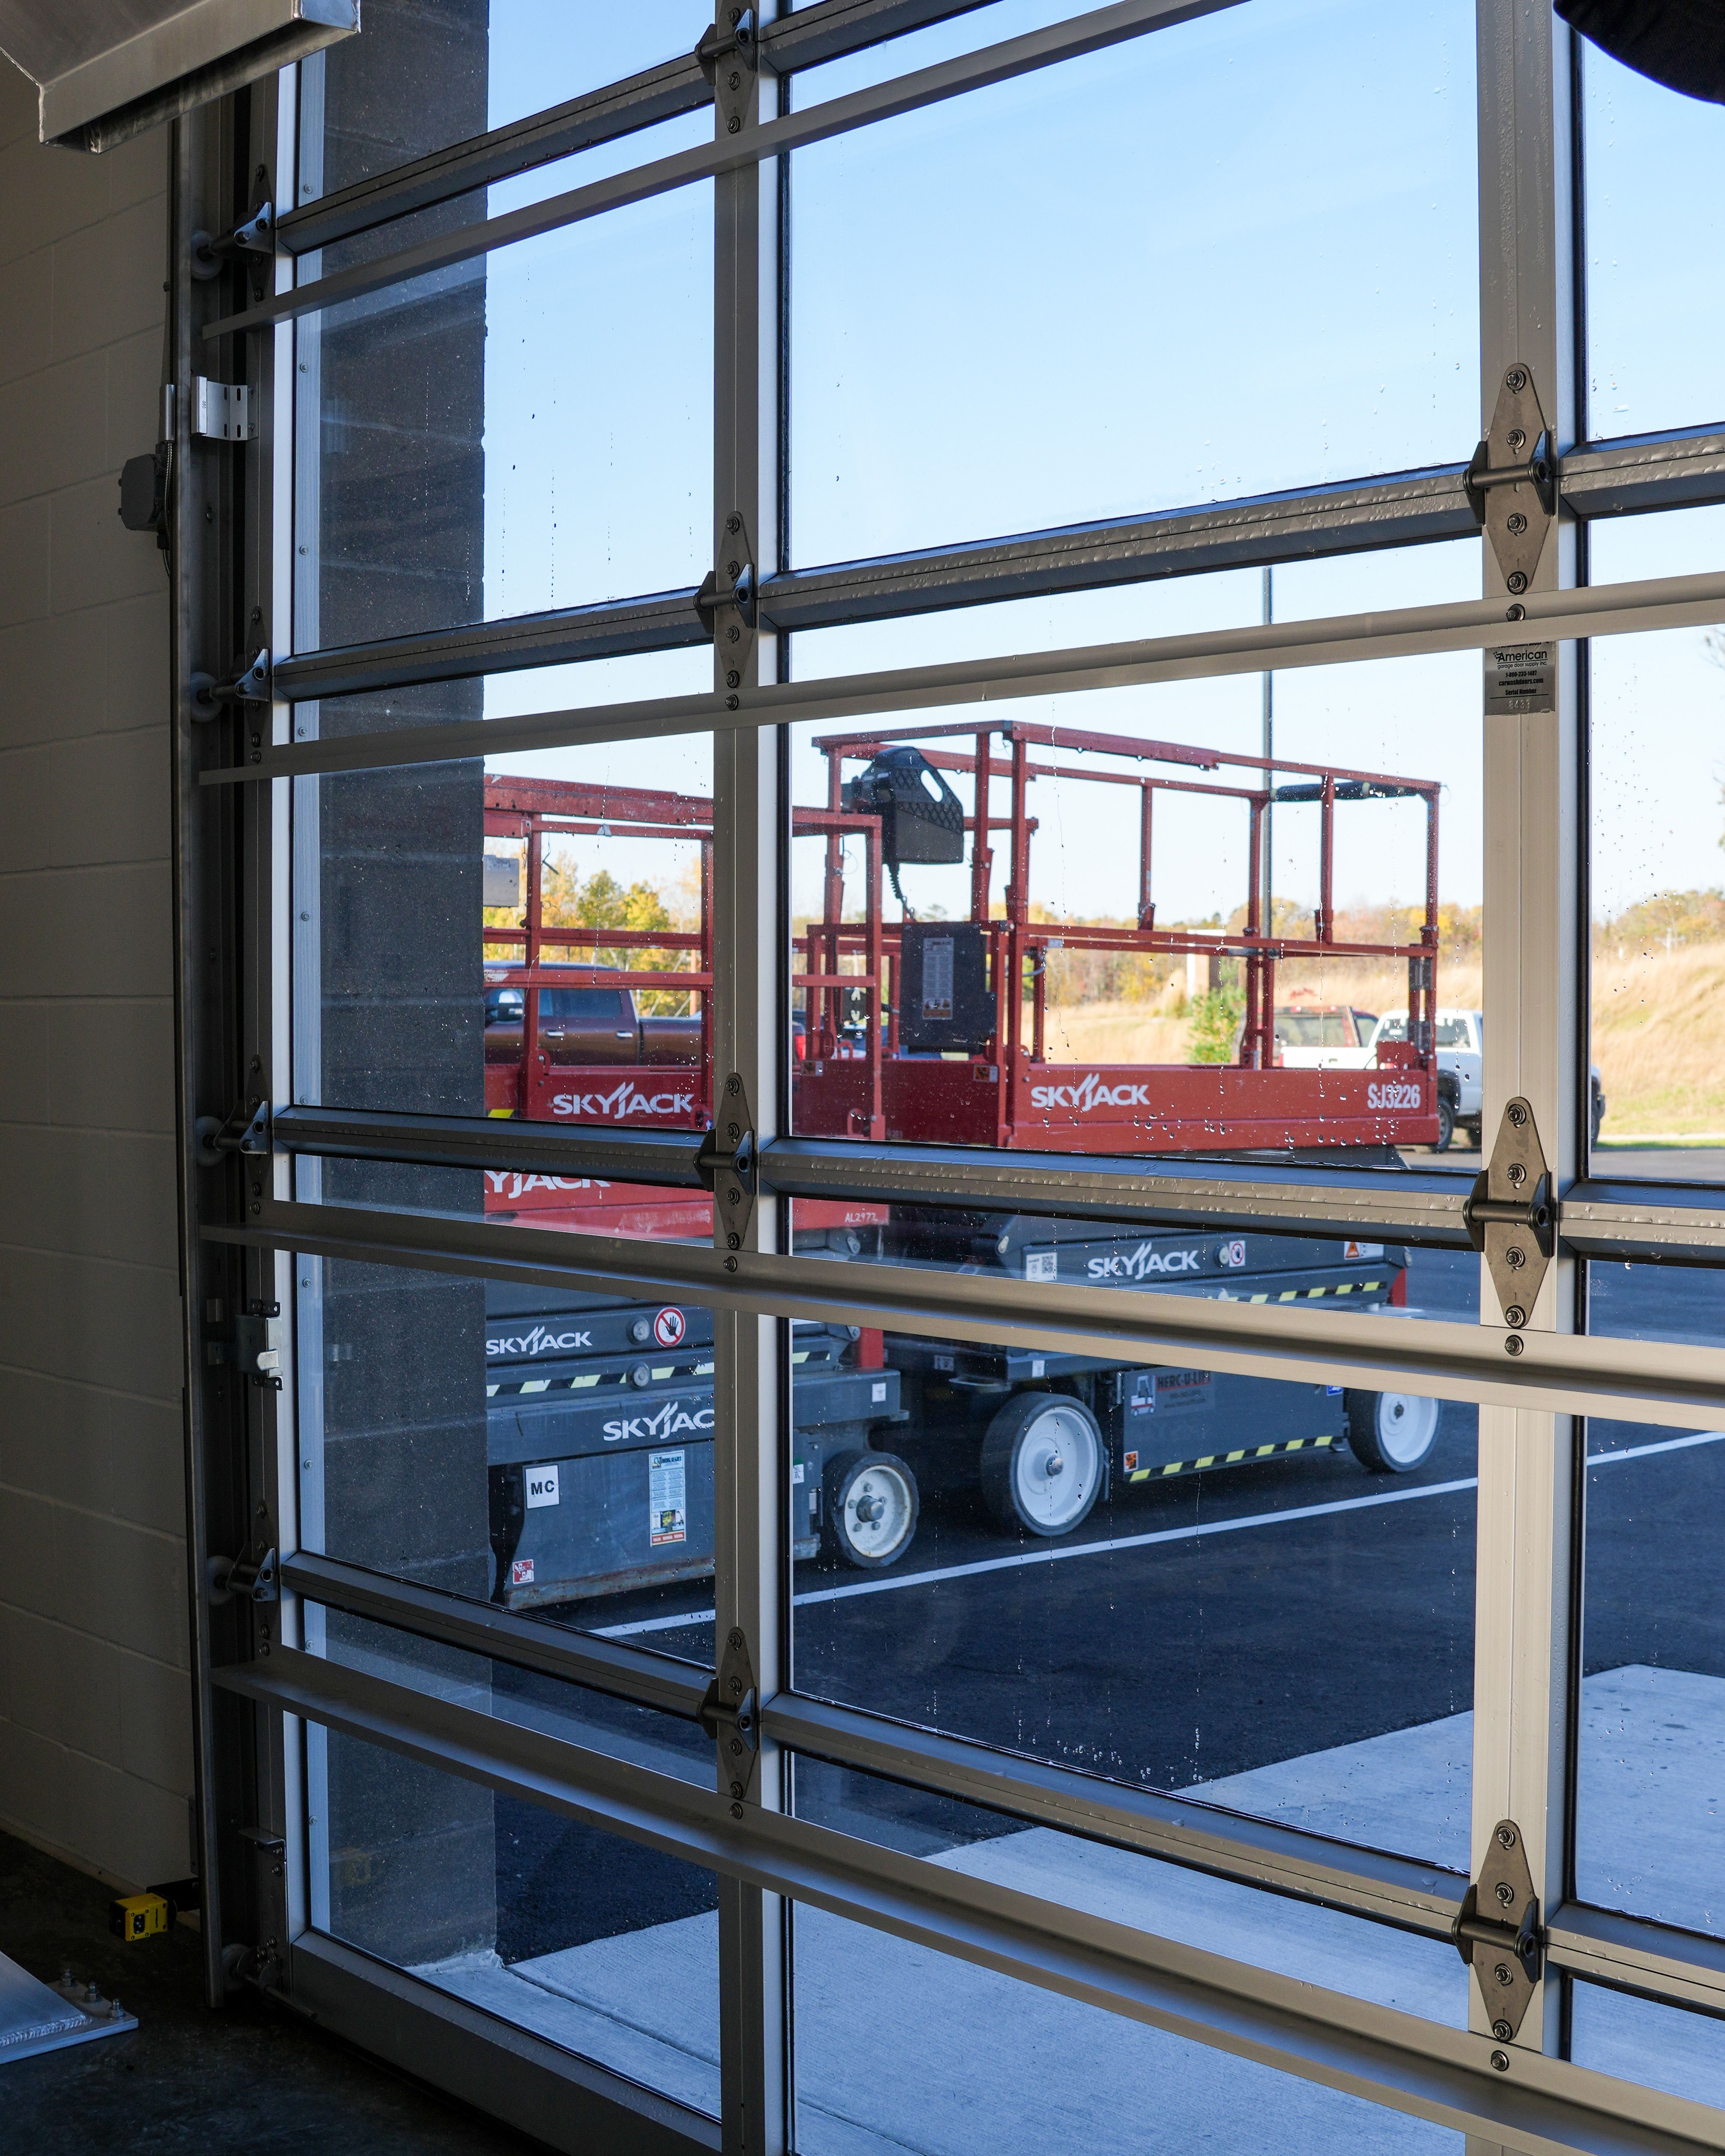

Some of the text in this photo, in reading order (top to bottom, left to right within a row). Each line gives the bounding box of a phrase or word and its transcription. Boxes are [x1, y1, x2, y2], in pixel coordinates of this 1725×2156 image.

[1498, 650, 1547, 662] American
[1498, 678, 1544, 686] carwashdoors.com
[553, 1082, 694, 1119] SKYJACK
[1031, 1073, 1151, 1112] SKYJACK
[1367, 1084, 1421, 1109] SJ3226
[1088, 1242, 1200, 1280] SKYJACK
[486, 1326, 593, 1355] SKYJACK
